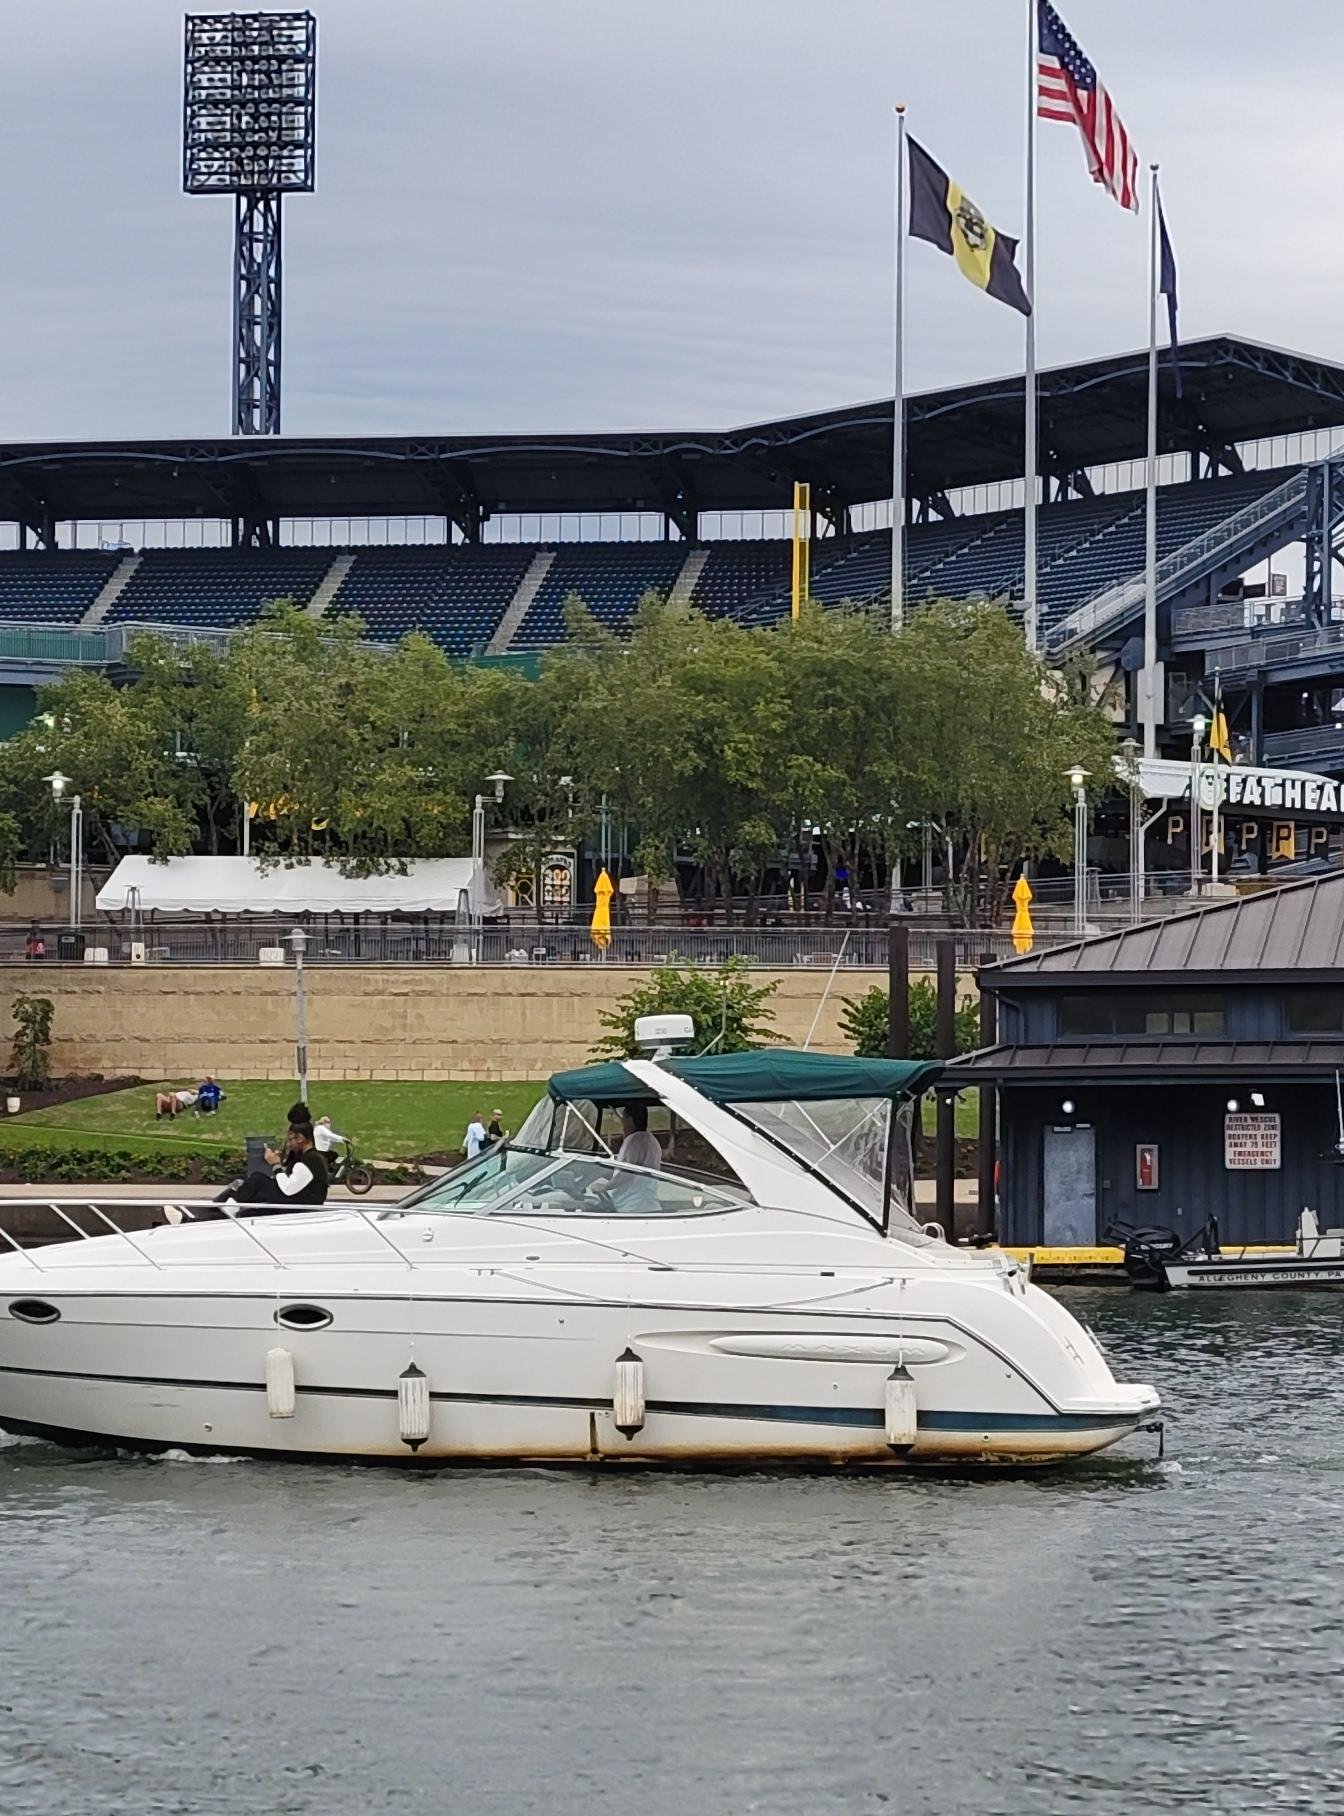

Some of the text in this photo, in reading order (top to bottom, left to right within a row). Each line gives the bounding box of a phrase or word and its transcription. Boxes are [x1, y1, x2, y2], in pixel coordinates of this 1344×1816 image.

[1229, 774, 1275, 806] FAT
[1274, 824, 1292, 852] P
[1198, 1273, 1267, 1282] ALLEGHENY
[1328, 1270, 1342, 1278] PA
